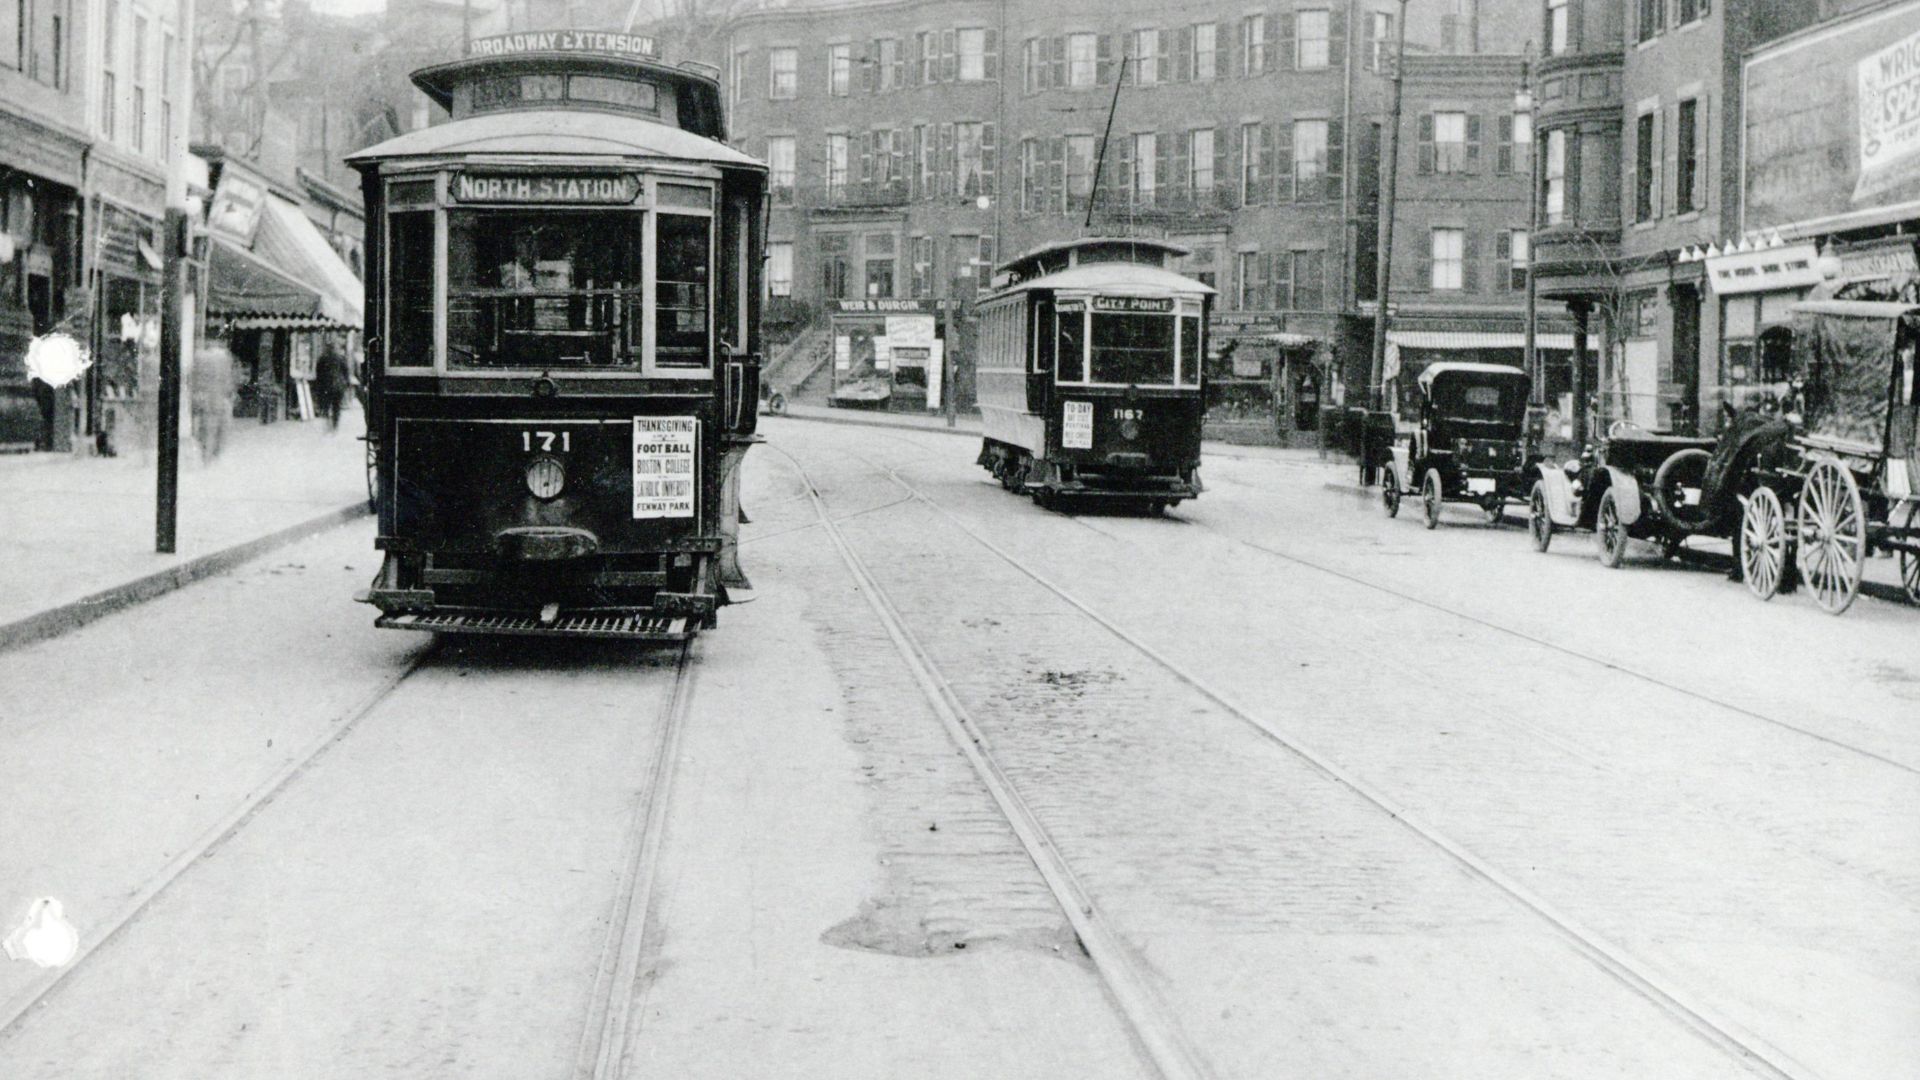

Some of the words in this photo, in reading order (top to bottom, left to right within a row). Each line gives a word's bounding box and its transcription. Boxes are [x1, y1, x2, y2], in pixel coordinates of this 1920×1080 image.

[471, 31, 557, 54] BROADWAY
[563, 31, 653, 54] EXTENSION
[460, 174, 531, 200] NORTH
[540, 178, 627, 200] STATION
[840, 300, 866, 311] WEIR
[878, 300, 919, 311] DURGIN
[1097, 297, 1127, 310] CITY
[1131, 299, 1170, 311] POINT
[1114, 408, 1144, 421] 1167
[637, 420, 693, 433] THANKSGIVING
[522, 431, 570, 453] 171
[637, 443, 663, 454] FOOT
[665, 443, 691, 454] BALL
[637, 459, 662, 474] BOSTON
[665, 459, 691, 474] COLLEGE
[637, 503, 667, 512] FENWAY
[669, 502, 690, 511] PARK
